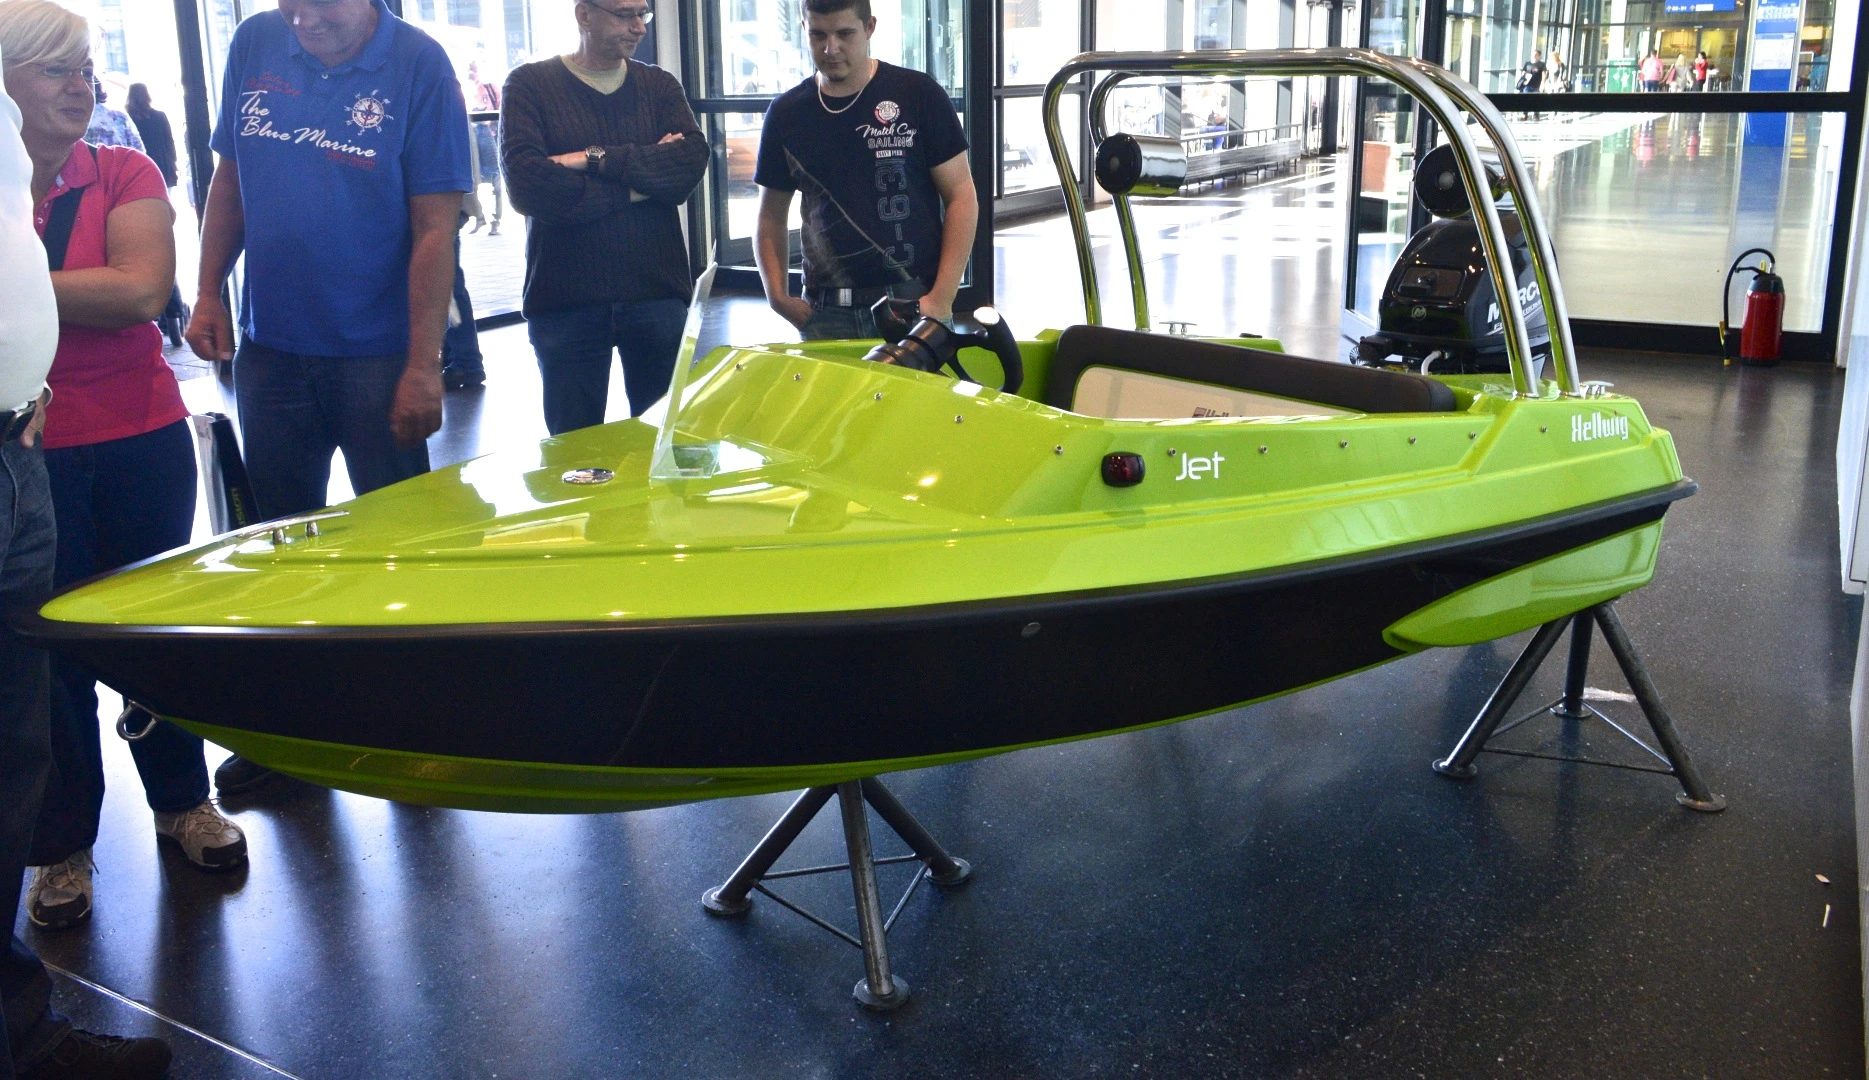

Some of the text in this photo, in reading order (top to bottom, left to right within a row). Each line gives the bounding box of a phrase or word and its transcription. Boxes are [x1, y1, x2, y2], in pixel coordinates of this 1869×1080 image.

[241, 90, 270, 116] The
[240, 116, 377, 157] Blue Marine
[855, 123, 917, 143] Match Cup
[867, 136, 914, 149] SAILING
[1571, 410, 1629, 443] Hellwig
[1175, 451, 1225, 481] Jet
